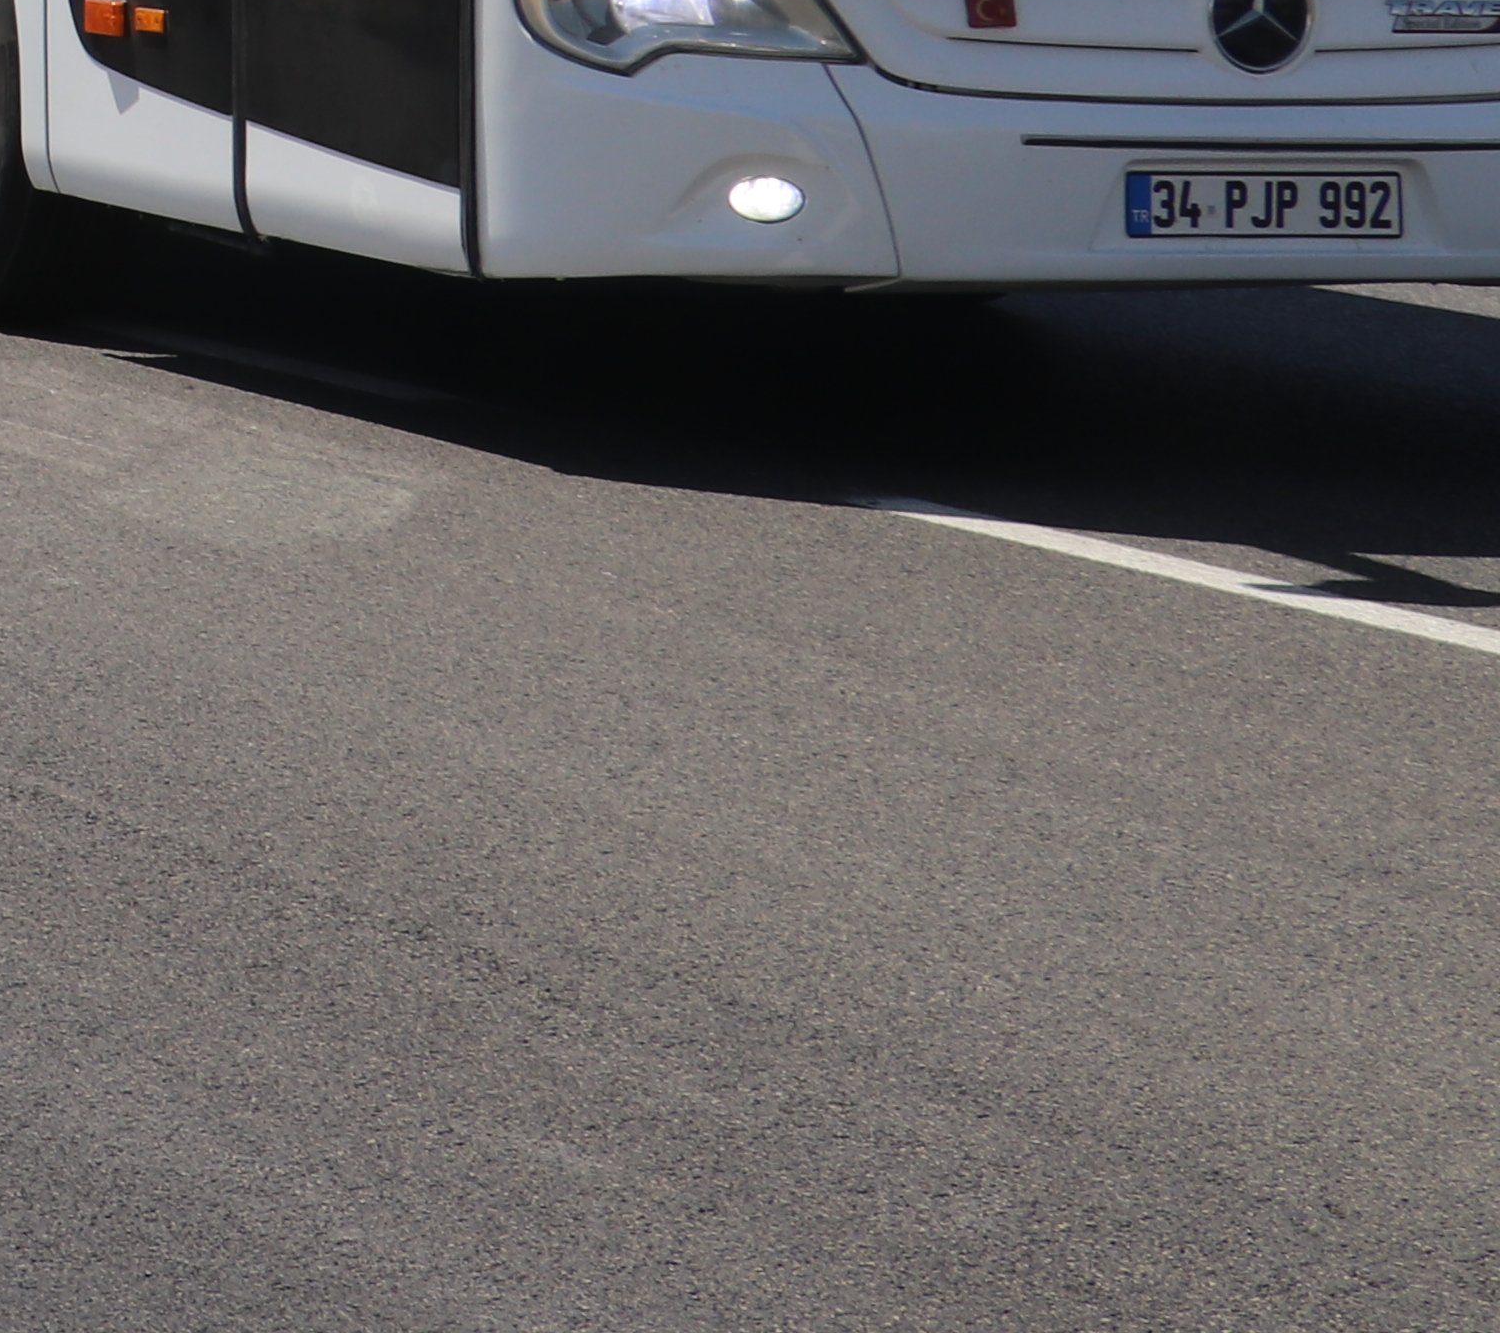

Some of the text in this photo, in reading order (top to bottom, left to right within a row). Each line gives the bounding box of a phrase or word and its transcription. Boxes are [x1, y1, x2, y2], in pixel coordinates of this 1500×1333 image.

[1132, 209, 1150, 223] TR
[1153, 181, 1392, 229] 34 PJP 992
